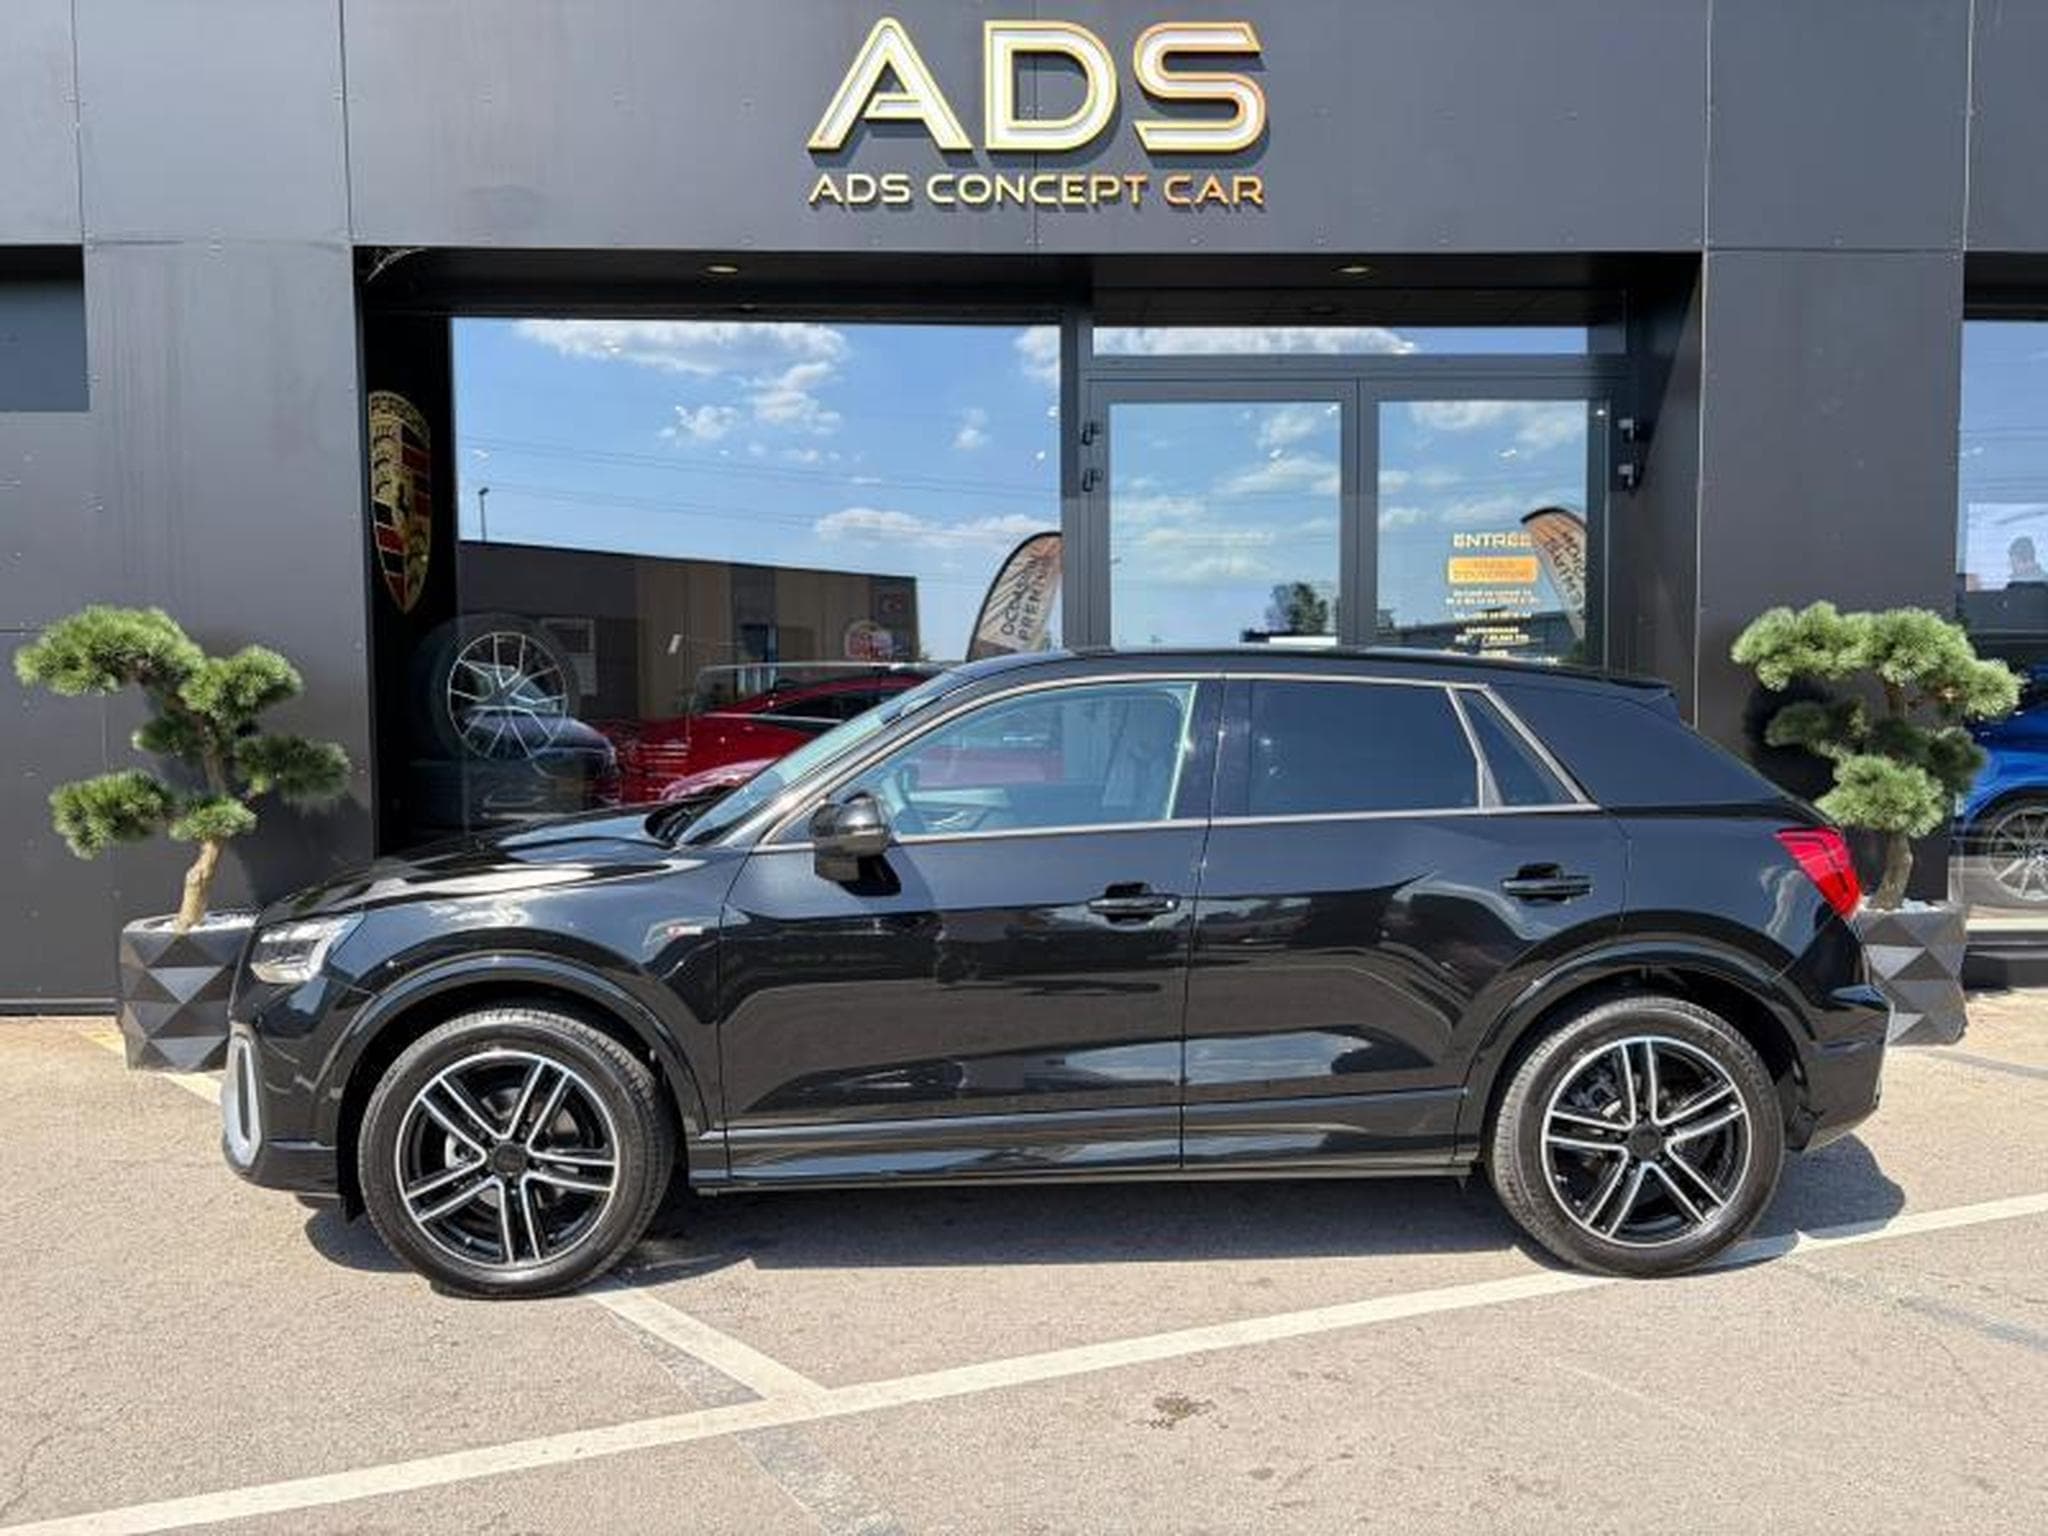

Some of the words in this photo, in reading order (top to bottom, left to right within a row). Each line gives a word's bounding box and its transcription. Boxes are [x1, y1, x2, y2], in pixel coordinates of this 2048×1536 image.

[806, 16, 1267, 152] ADS
[809, 173, 911, 205] ADS
[925, 173, 1146, 205] CONCEPT
[1163, 173, 1265, 205] CAR
